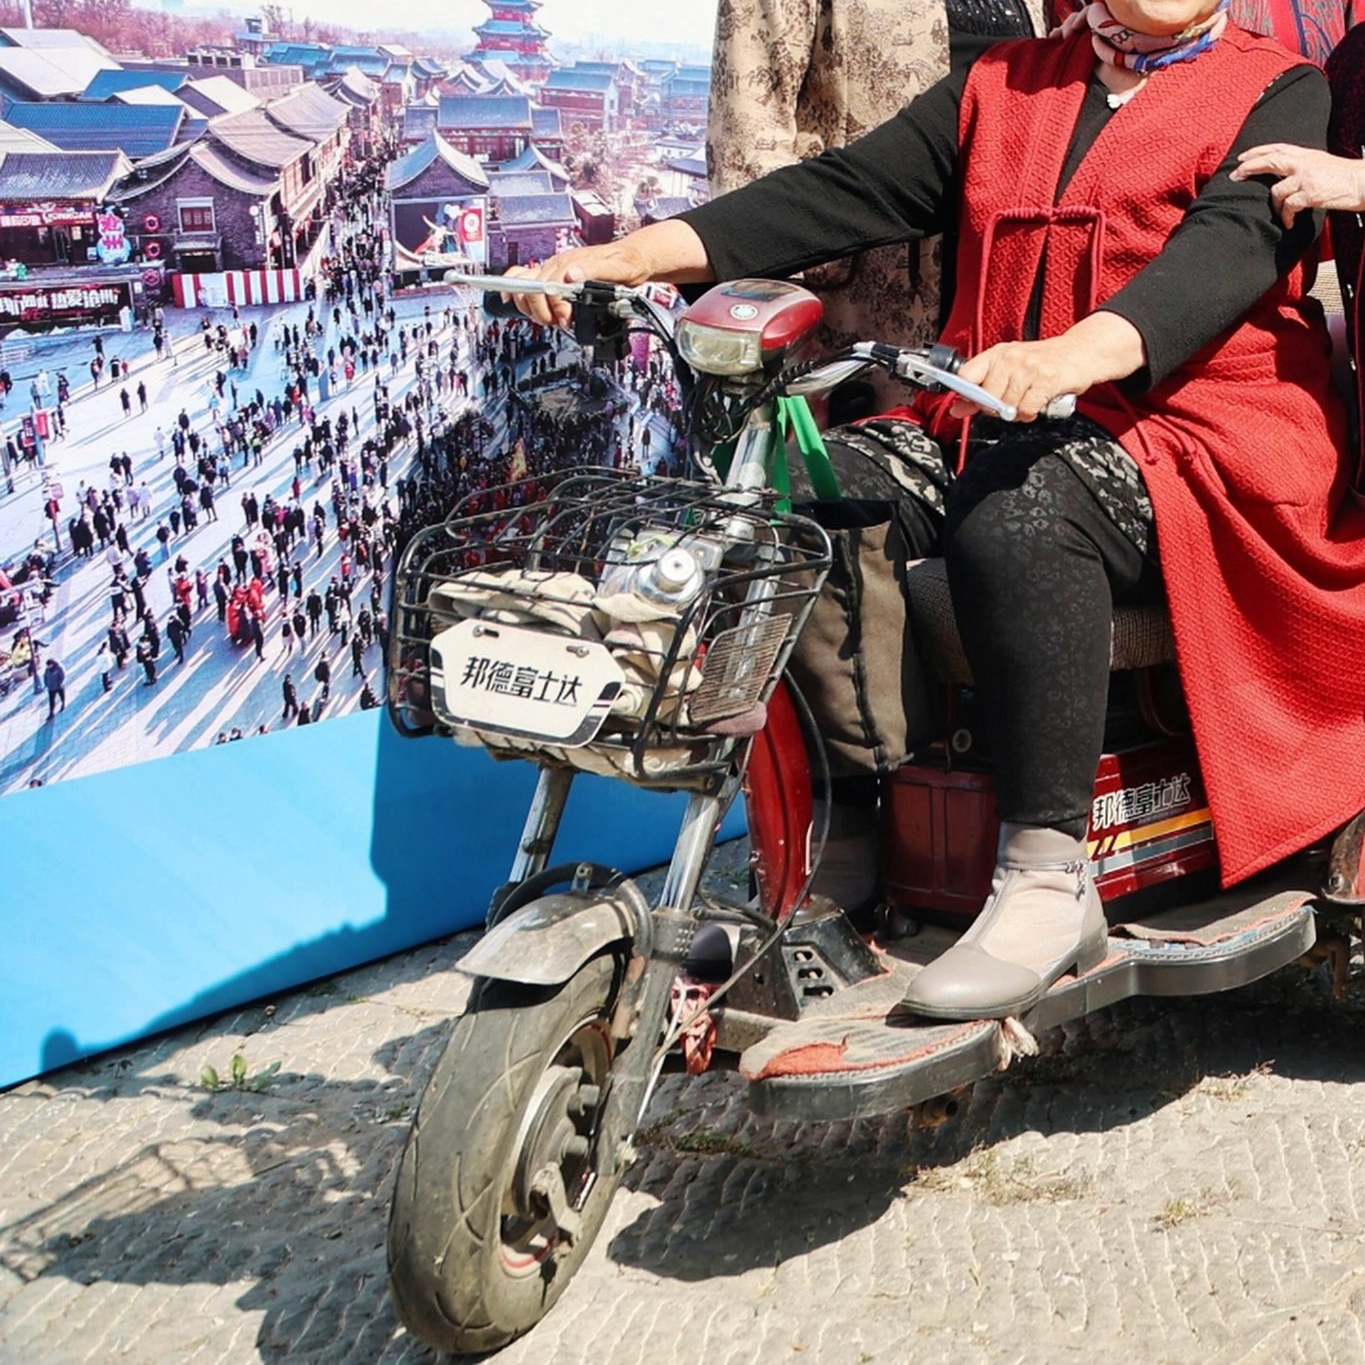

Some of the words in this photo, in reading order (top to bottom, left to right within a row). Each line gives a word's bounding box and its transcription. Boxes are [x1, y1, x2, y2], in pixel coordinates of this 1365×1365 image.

[460, 656, 583, 707] 邦德富士达
[1092, 773, 1191, 831] 邦德富士达
